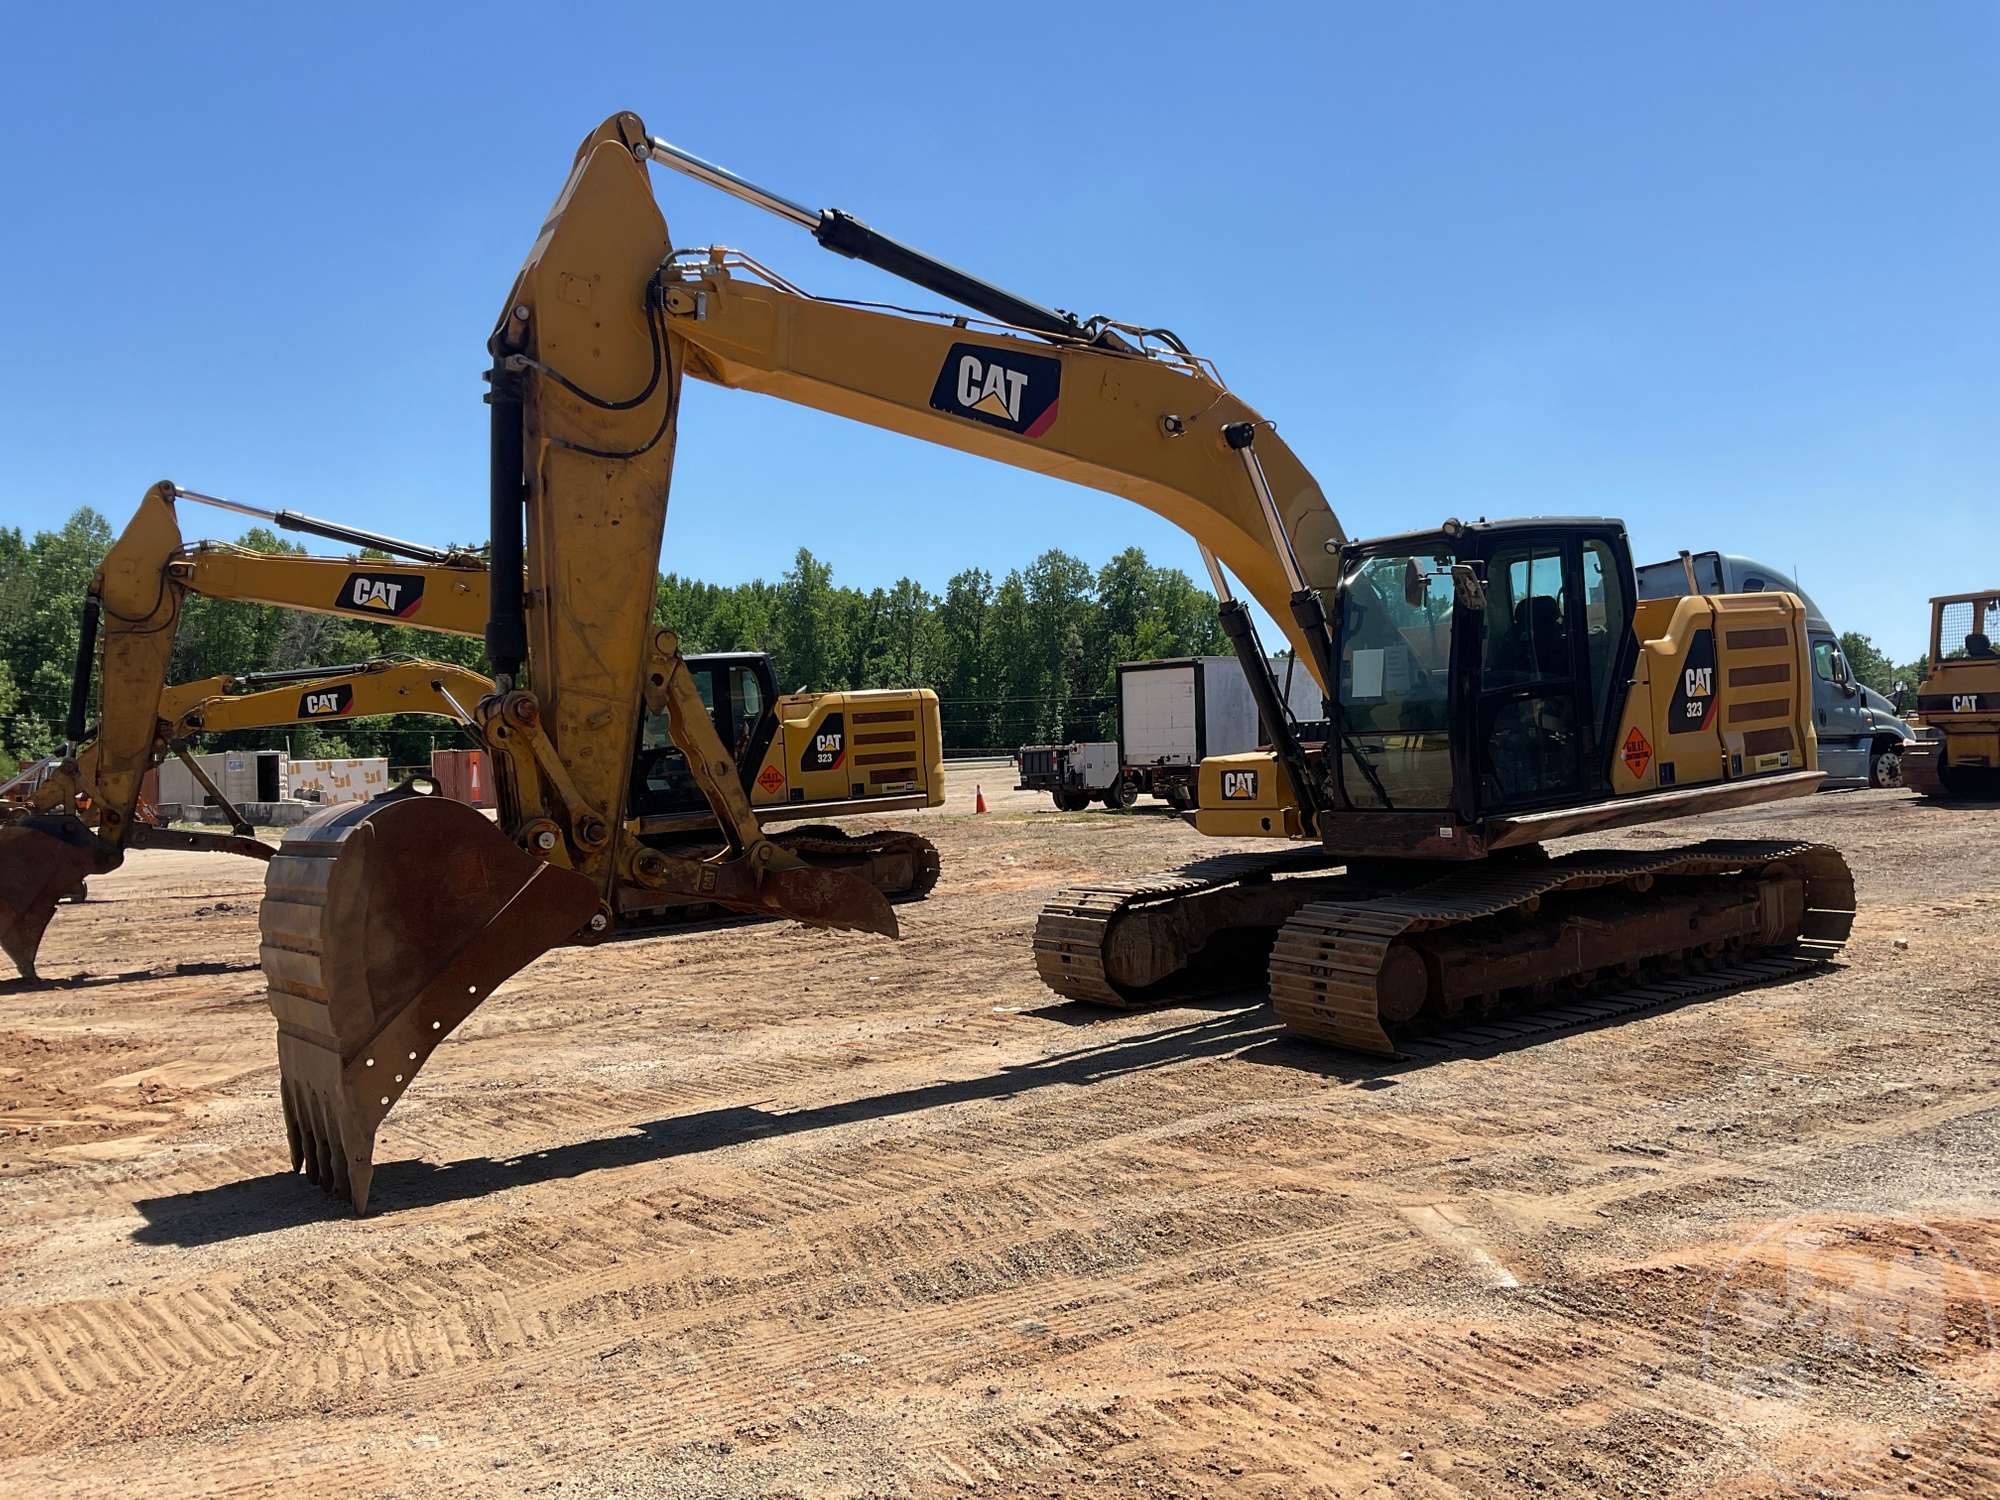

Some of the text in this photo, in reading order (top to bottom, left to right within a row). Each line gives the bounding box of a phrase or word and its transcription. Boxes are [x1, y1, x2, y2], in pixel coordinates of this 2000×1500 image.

[957, 355, 1028, 422] CAT
[353, 578, 401, 611] CAT
[1685, 668, 1712, 697] CAT
[306, 693, 338, 714] CAT
[1686, 701, 1702, 718] 323
[1952, 695, 1977, 712] CAT
[816, 734, 841, 751] CAT
[817, 753, 833, 763] 323
[1225, 772, 1254, 797] CAT
